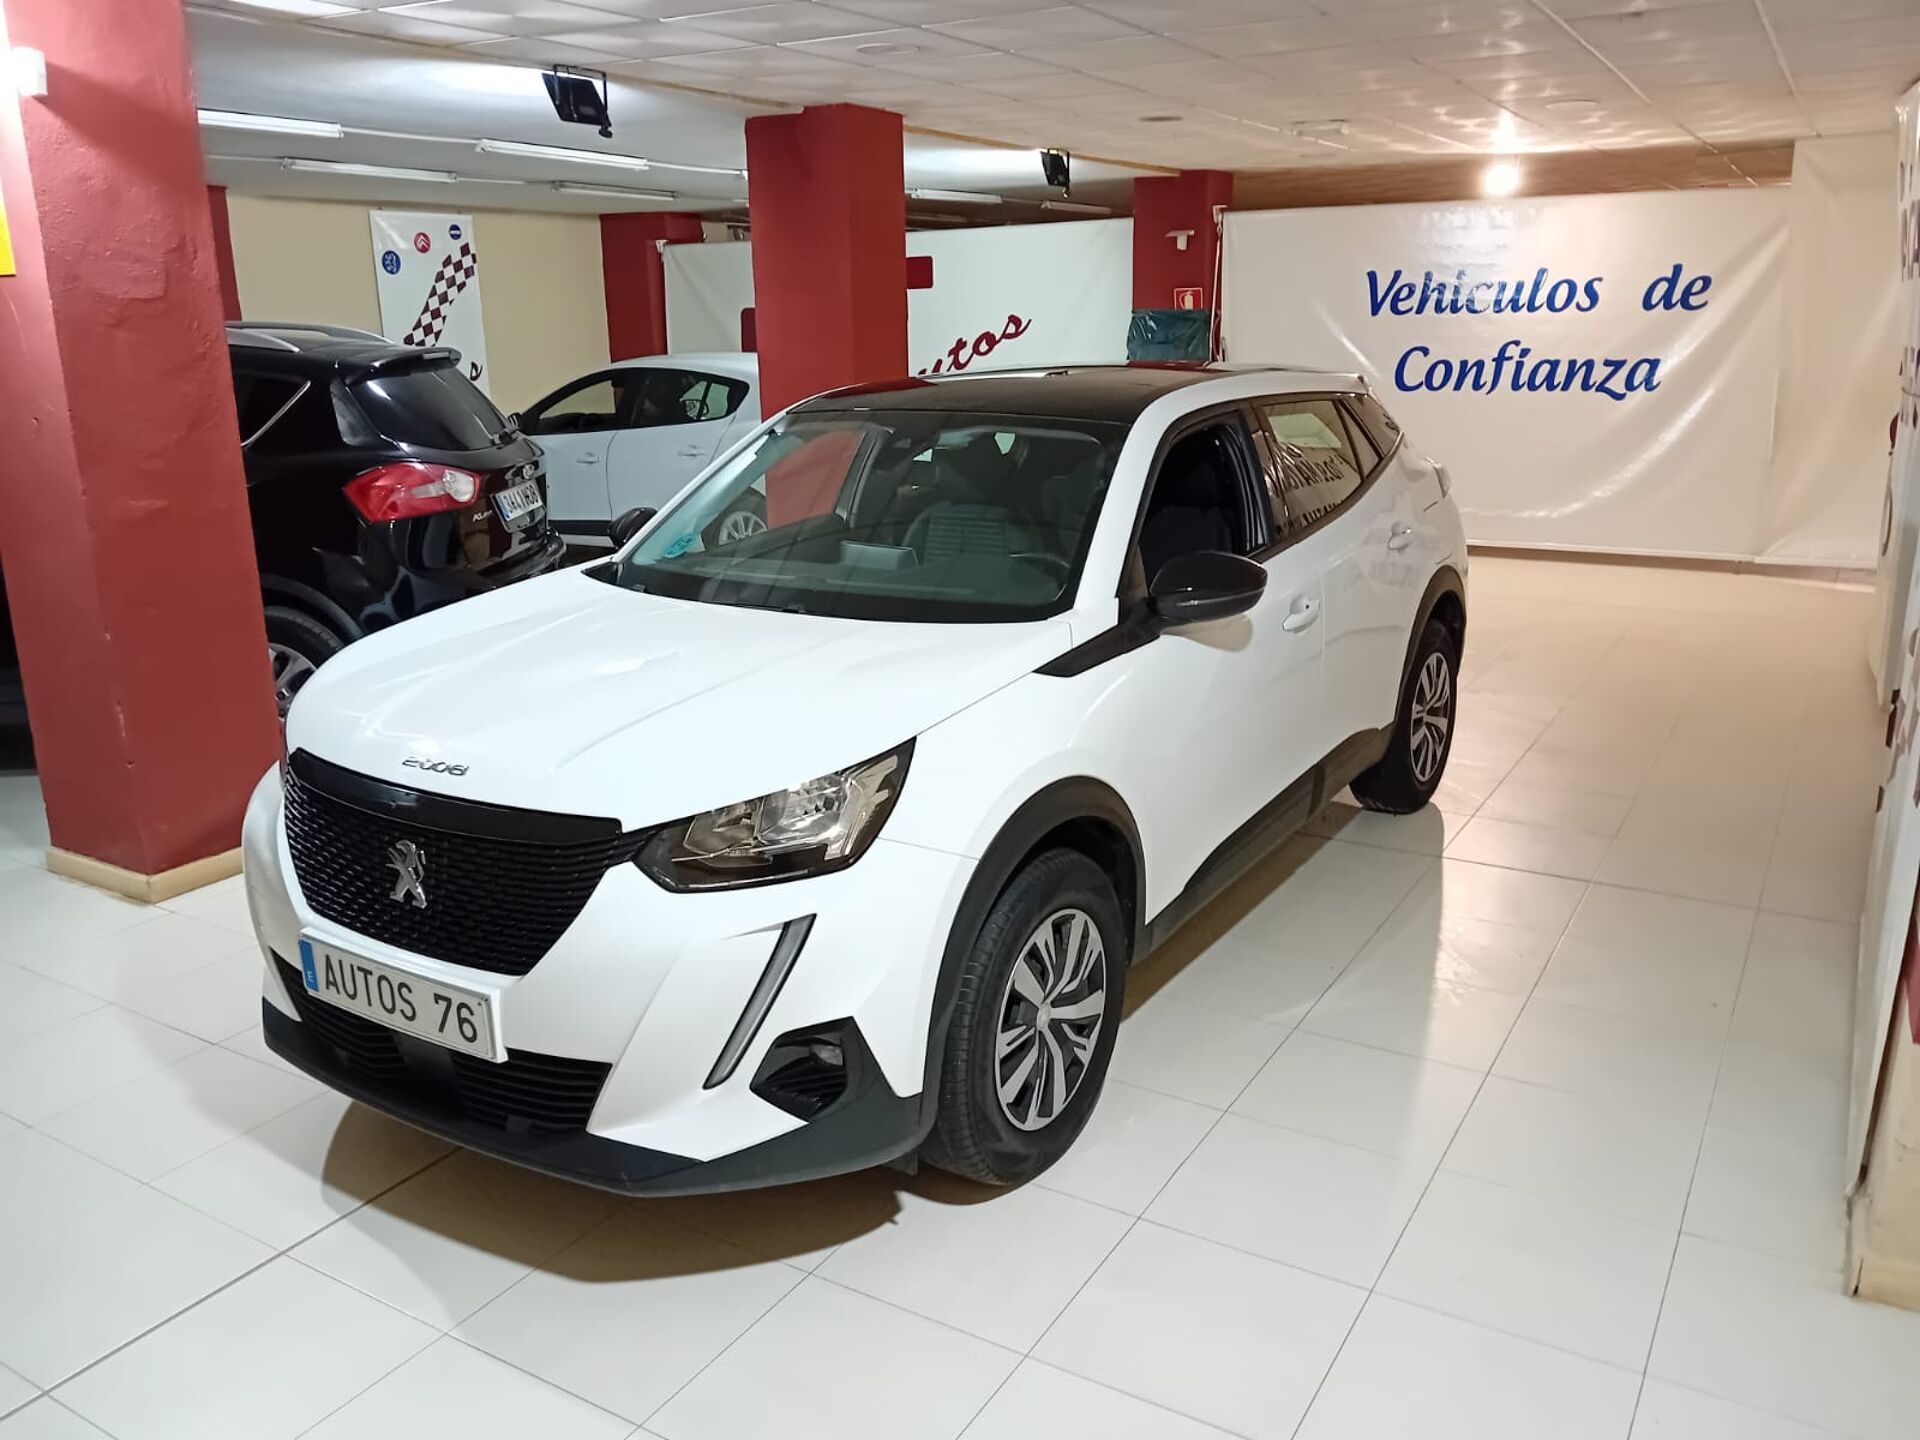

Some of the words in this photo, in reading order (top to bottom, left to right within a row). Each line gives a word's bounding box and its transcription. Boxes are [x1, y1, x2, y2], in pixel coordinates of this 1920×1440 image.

[1641, 263, 1712, 312] de
[1395, 339, 1661, 401] Confianza
[325, 954, 416, 1022] AUTOS
[434, 993, 477, 1043] 76
